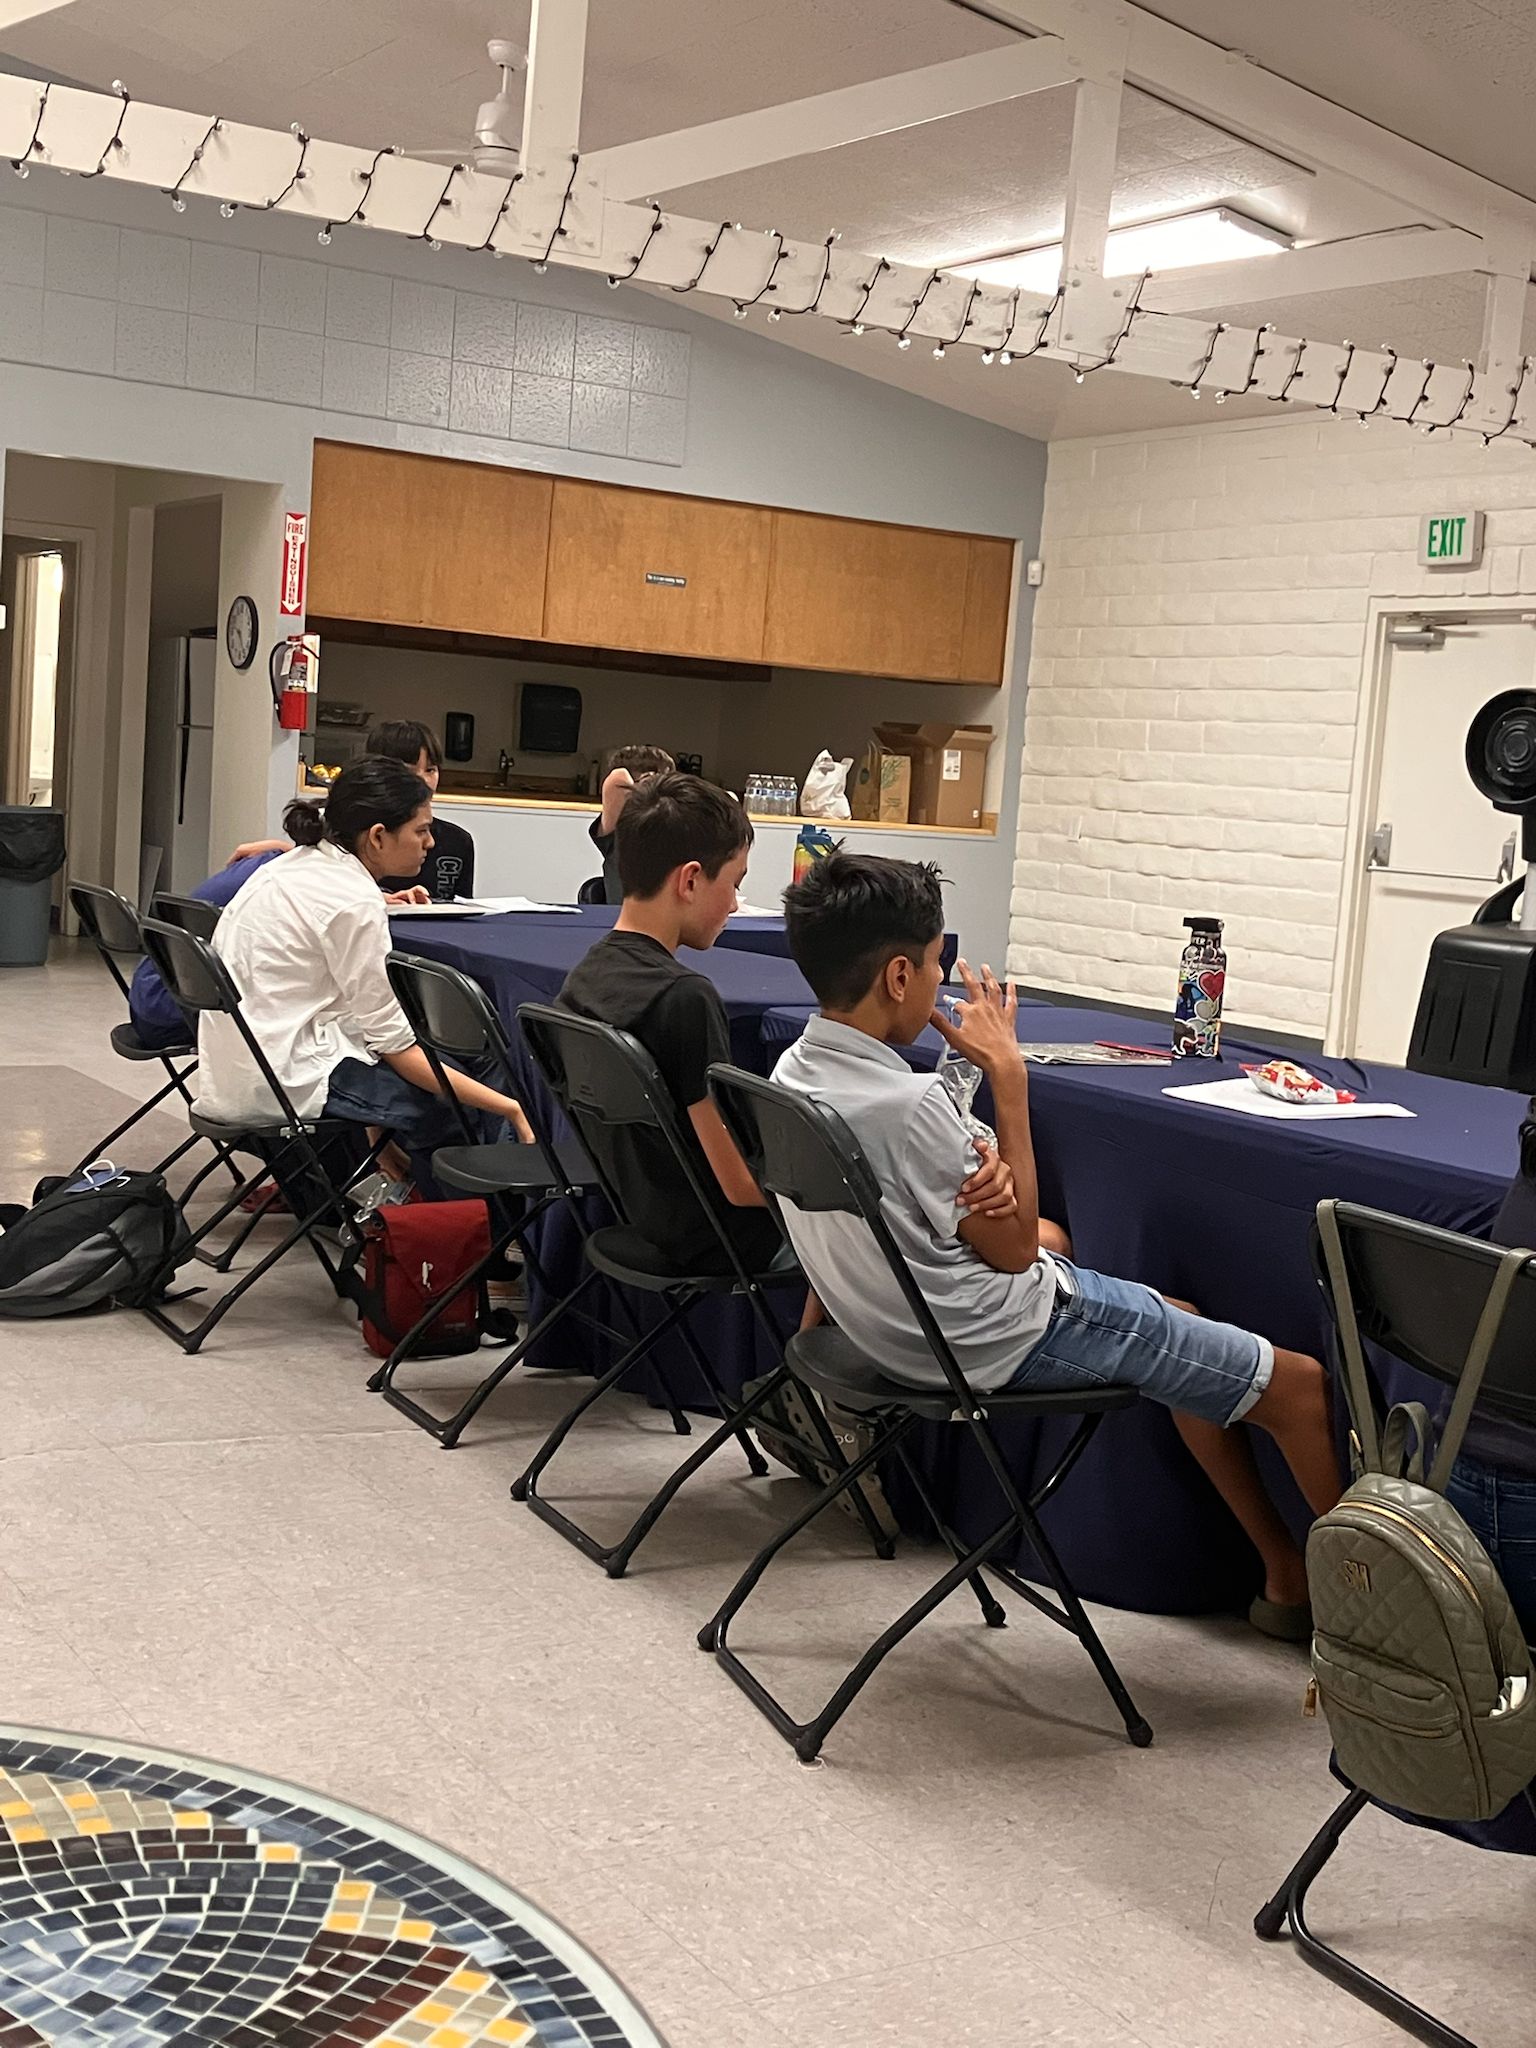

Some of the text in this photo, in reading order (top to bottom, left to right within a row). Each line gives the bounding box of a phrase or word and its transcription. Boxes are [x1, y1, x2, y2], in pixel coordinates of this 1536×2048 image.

[287, 522, 304, 535] FIRE
[1428, 517, 1466, 557] EXIT
[288, 535, 299, 605] EXTINGUISHER
